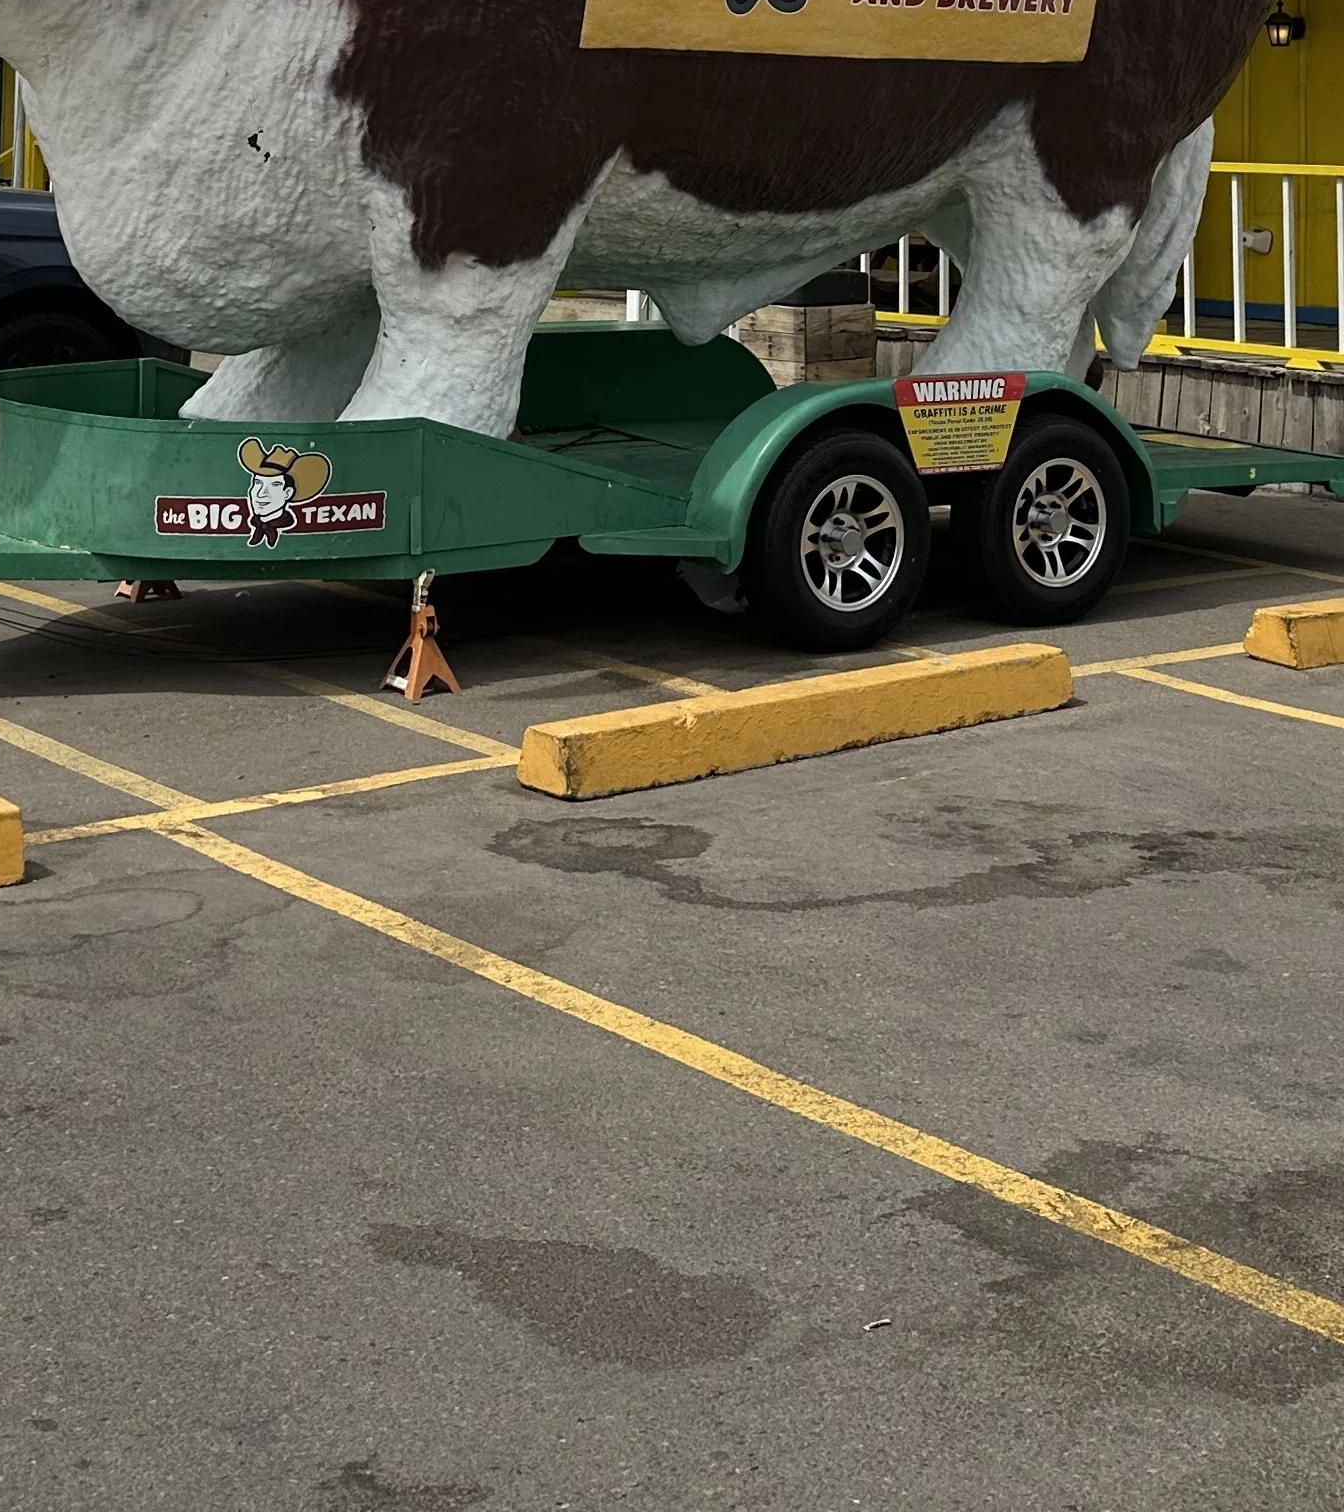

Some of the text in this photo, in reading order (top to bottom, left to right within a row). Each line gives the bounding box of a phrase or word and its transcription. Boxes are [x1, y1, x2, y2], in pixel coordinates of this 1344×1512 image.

[912, 377, 1006, 403] WARNING
[913, 404, 1008, 419] GRAFFITI IS A CRIME
[162, 502, 377, 530] the BIG TEXAN
